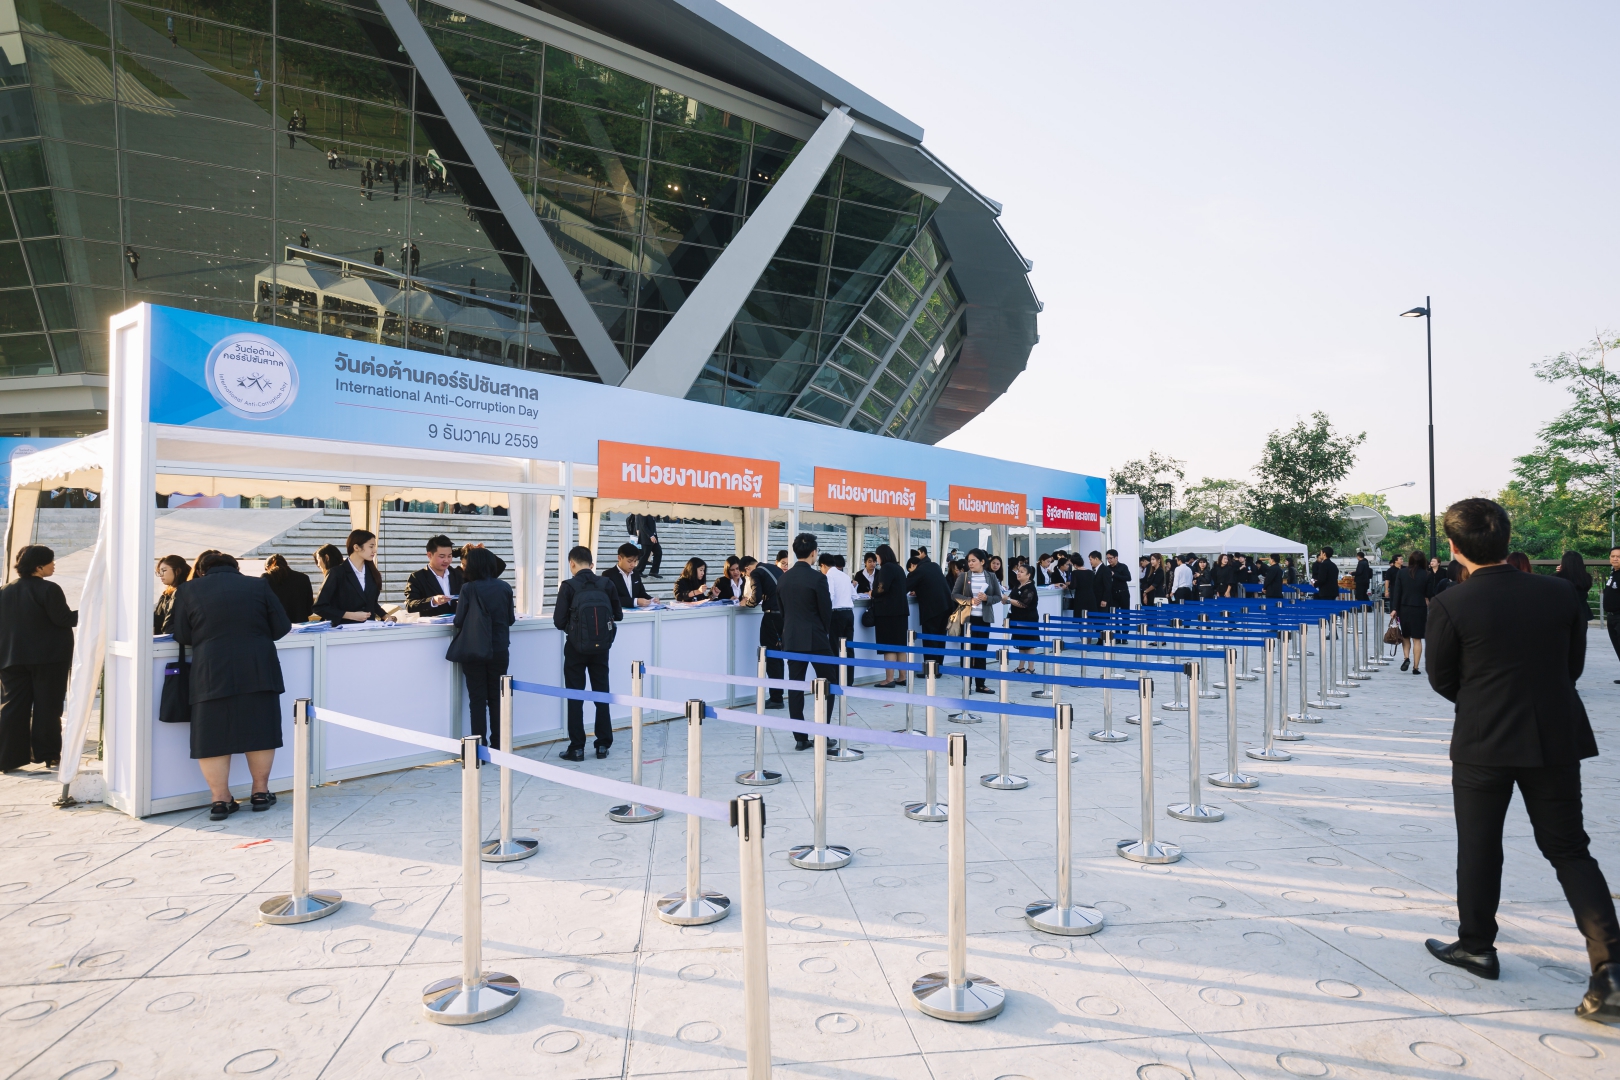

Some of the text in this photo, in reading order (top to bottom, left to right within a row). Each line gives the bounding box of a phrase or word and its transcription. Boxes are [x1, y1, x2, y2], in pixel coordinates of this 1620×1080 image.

[235, 344, 275, 357] วันต่อต้าน
[219, 373, 243, 403] International
[334, 351, 539, 401] วันต่อต้านคอร์รัปชันสากล
[335, 378, 539, 420] International Anti-Corruption Day
[428, 423, 539, 449] 9 ธันวาคม 2559
[621, 456, 763, 499] หน่วยงานภาครัฐ
[827, 478, 916, 511] หน่วยงานภาครัฐ
[959, 494, 1019, 519] หน่วยงานภาครัฐ
